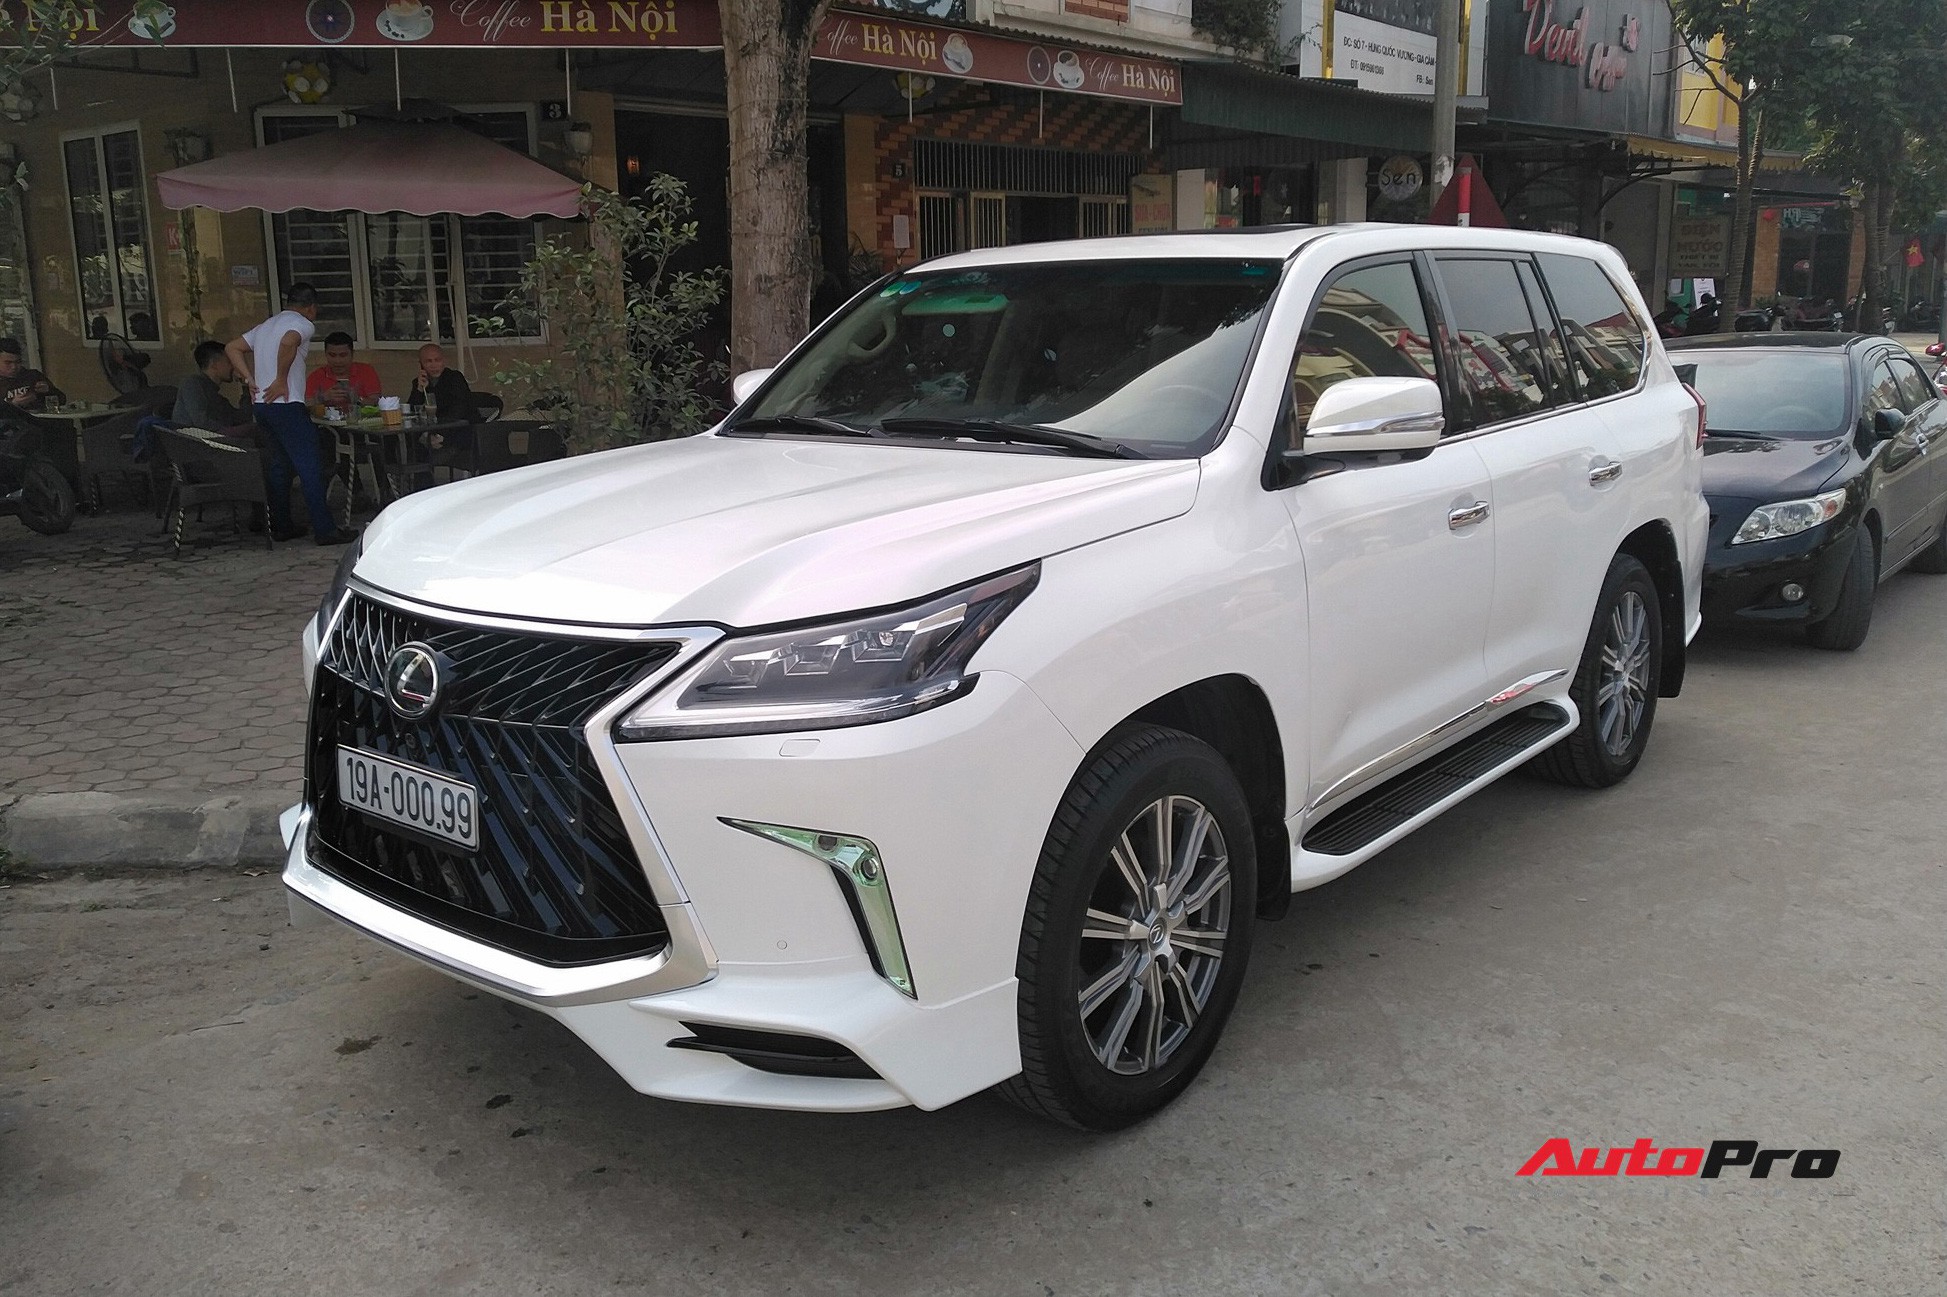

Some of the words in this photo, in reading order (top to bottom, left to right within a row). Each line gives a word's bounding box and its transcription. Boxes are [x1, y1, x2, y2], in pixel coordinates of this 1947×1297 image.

[450, 0, 531, 42] Coffee
[540, 0, 599, 33] Hà
[607, 0, 678, 40] Nội
[862, 23, 895, 55] Hà
[899, 29, 937, 65] Nội
[1085, 57, 1119, 91] Coffee
[1121, 64, 1145, 88] Hà
[1147, 67, 1175, 97] Nội
[1382, 168, 1416, 186] Sen
[346, 756, 472, 839] 19A-000.99
